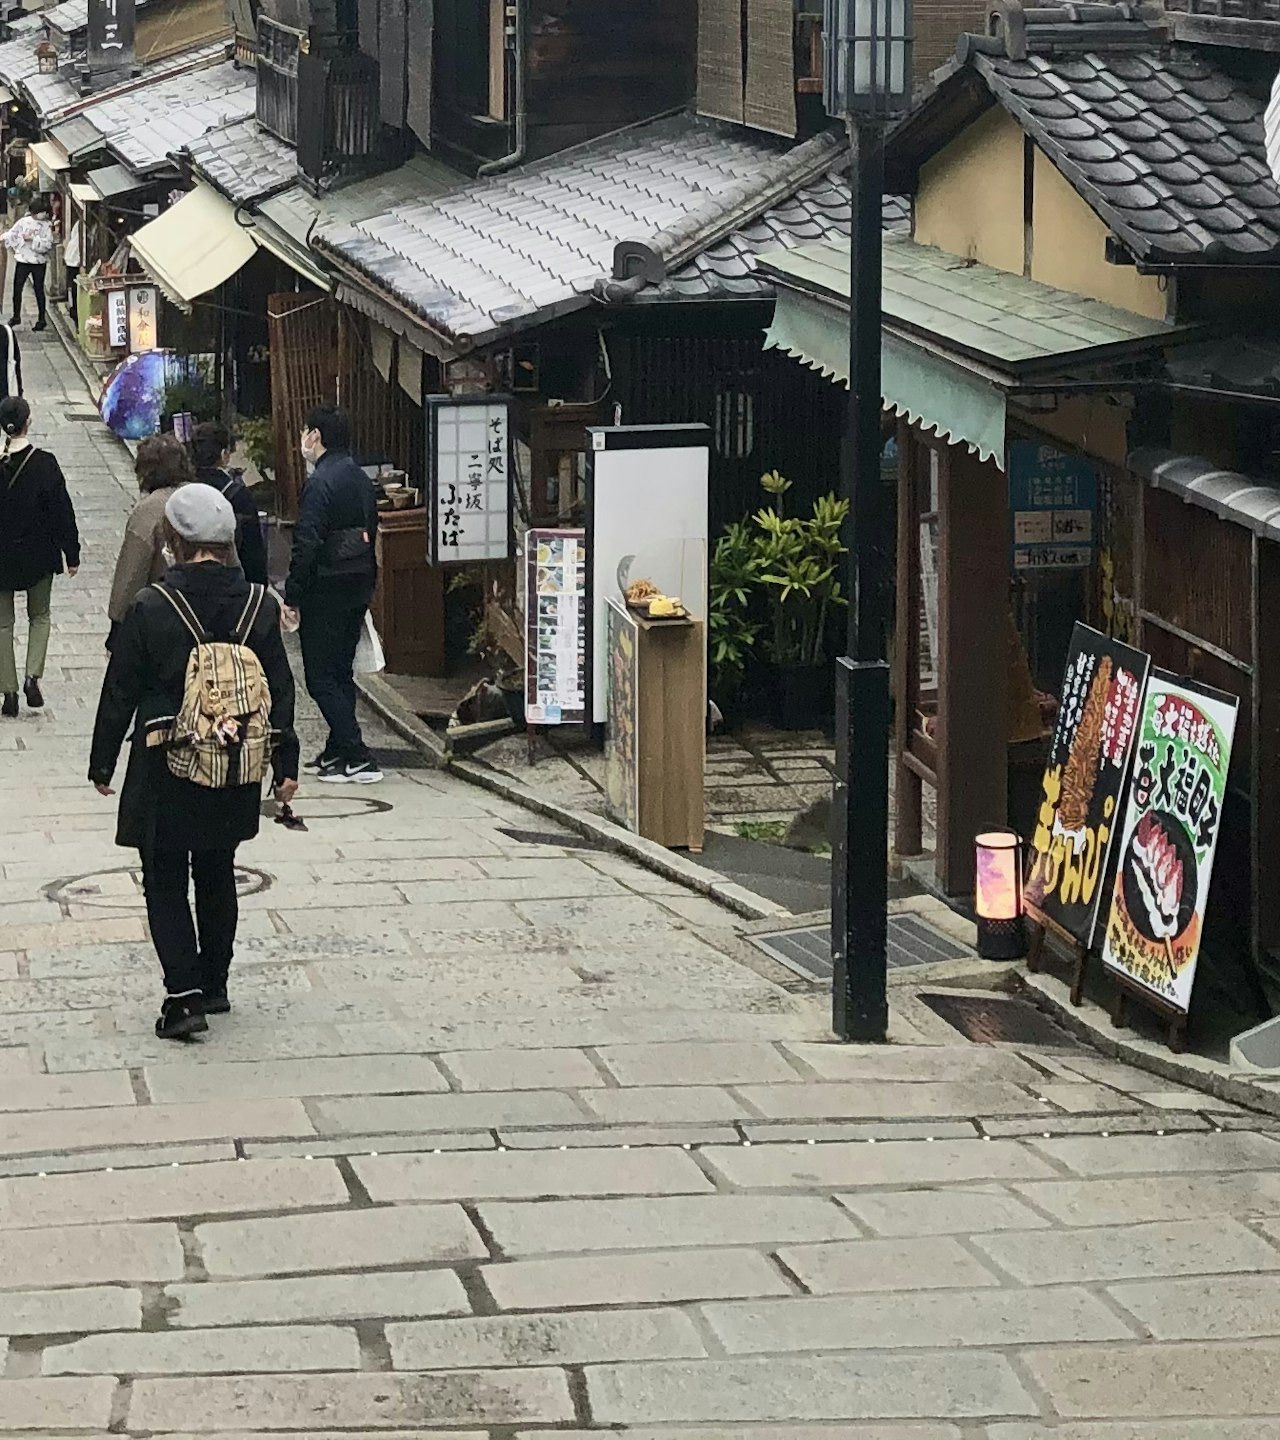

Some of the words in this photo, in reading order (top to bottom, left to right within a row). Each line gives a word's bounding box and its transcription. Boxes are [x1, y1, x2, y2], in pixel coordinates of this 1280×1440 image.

[487, 416, 505, 475] そば処
[465, 454, 484, 511] 二寧坂
[440, 482, 465, 547] ふたば
